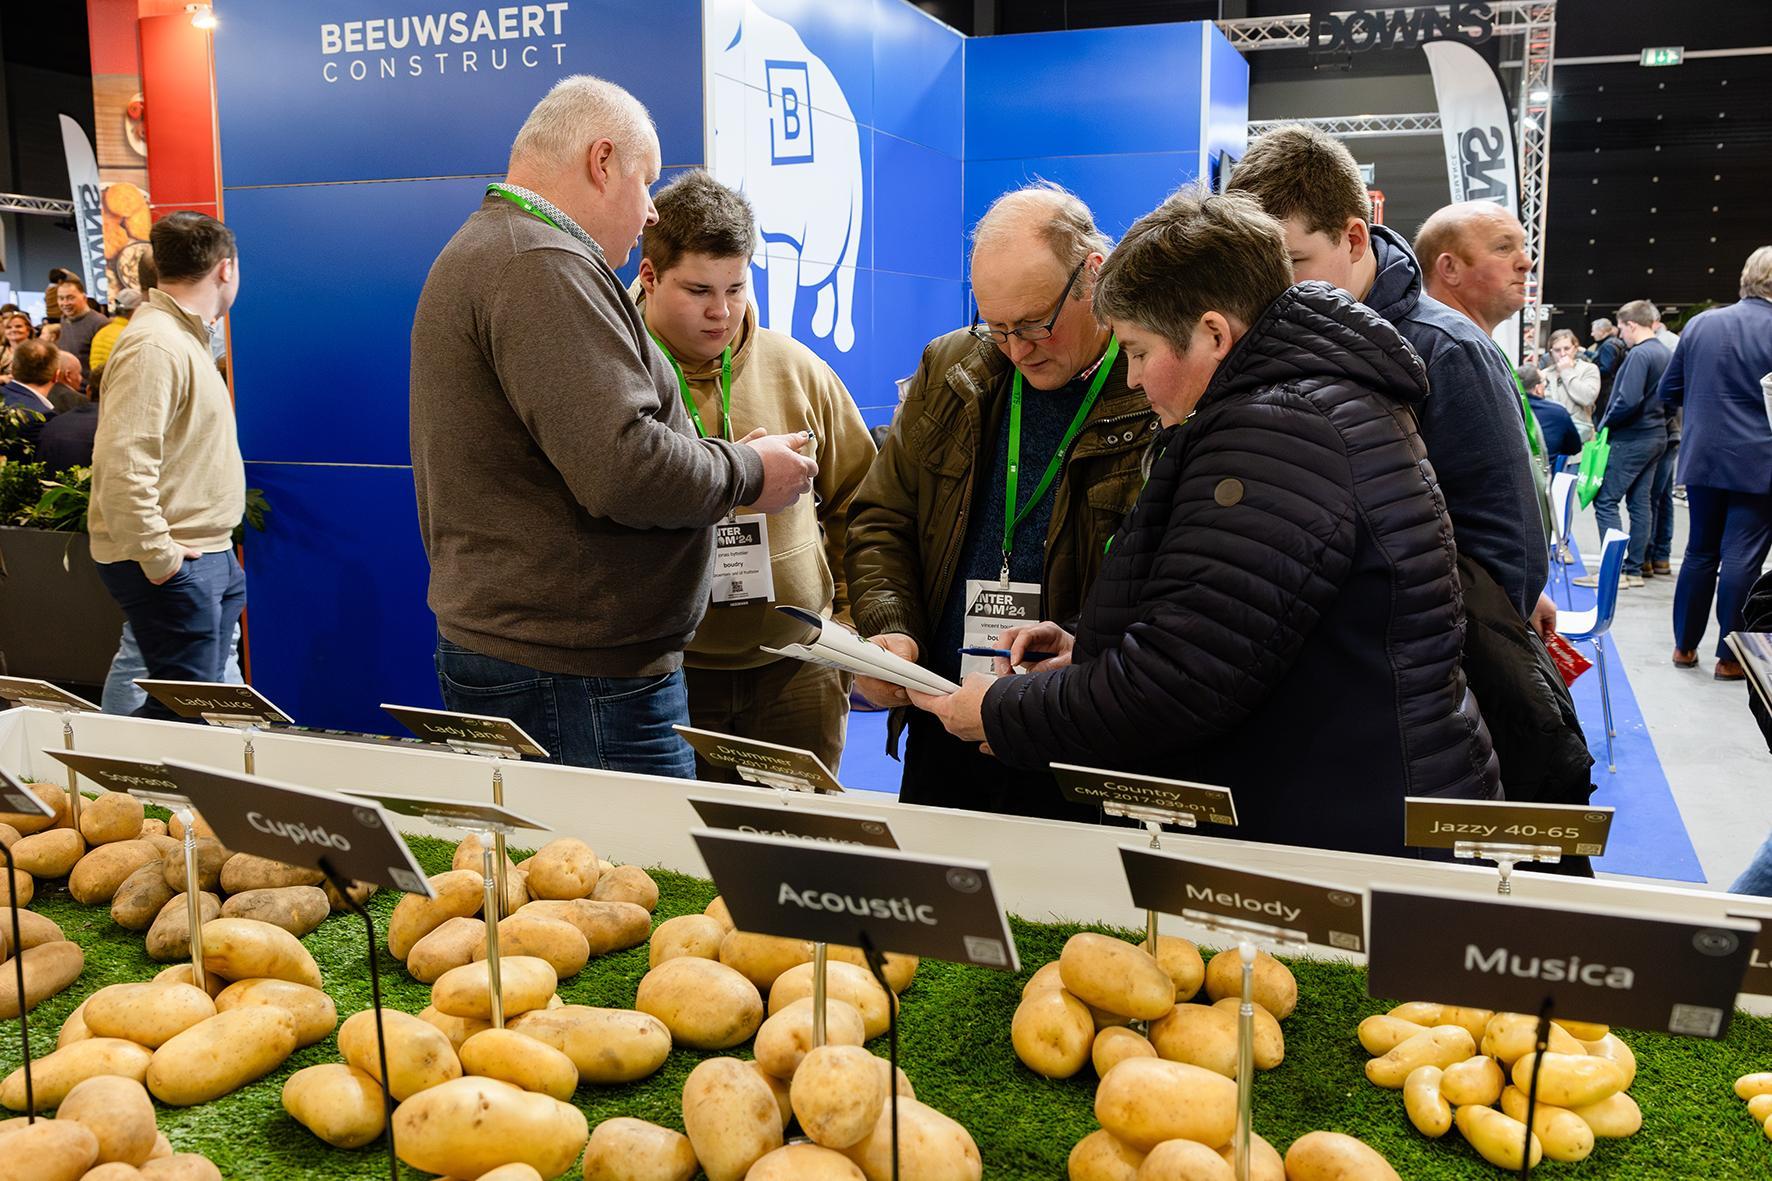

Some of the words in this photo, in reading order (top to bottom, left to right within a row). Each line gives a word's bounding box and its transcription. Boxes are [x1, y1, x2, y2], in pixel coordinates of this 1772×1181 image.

[320, 2, 569, 54] BEEUWSAERT
[1308, 1, 1494, 53] DOWNS
[323, 43, 567, 83] CONSTRUCT
[781, 87, 801, 140] B
[174, 696, 215, 709] Lady
[214, 698, 255, 709] Luce
[423, 722, 465, 738] Lady
[467, 728, 508, 741] Jane
[717, 745, 792, 767] Drummer
[1074, 786, 1110, 798] CMK
[1113, 792, 1216, 813] 2017-039-011
[1103, 781, 1182, 801] Country
[246, 811, 351, 851] Cupido
[1430, 820, 1498, 837] Jazzy
[1504, 824, 1580, 839] 40-65
[777, 881, 939, 926] Acoustic
[1186, 883, 1301, 922] Melody
[1464, 944, 1636, 990] Musica
